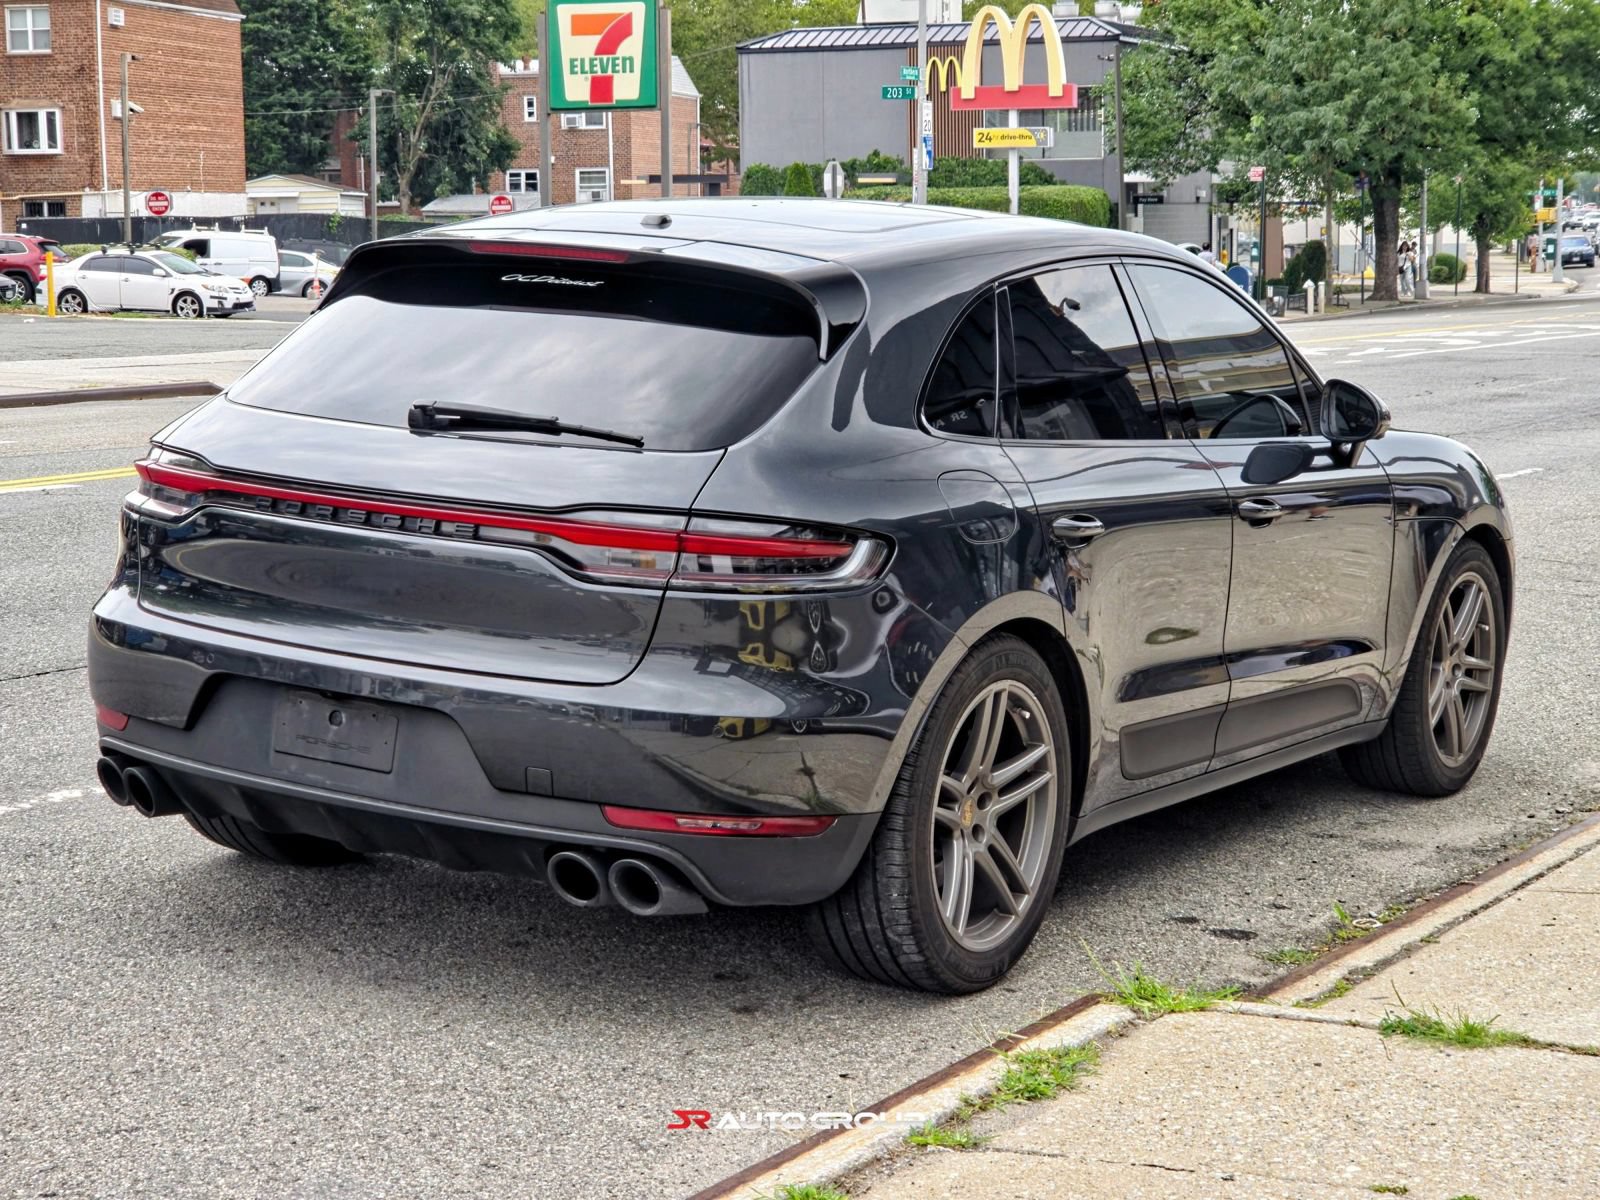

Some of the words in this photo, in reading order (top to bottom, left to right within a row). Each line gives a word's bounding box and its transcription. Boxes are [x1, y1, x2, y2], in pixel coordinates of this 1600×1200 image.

[887, 87, 903, 98] 203
[923, 118, 933, 132] 20
[977, 132, 993, 143] 24
[1000, 133, 1033, 141] drive-thru
[255, 496, 478, 539] PORSCHE
